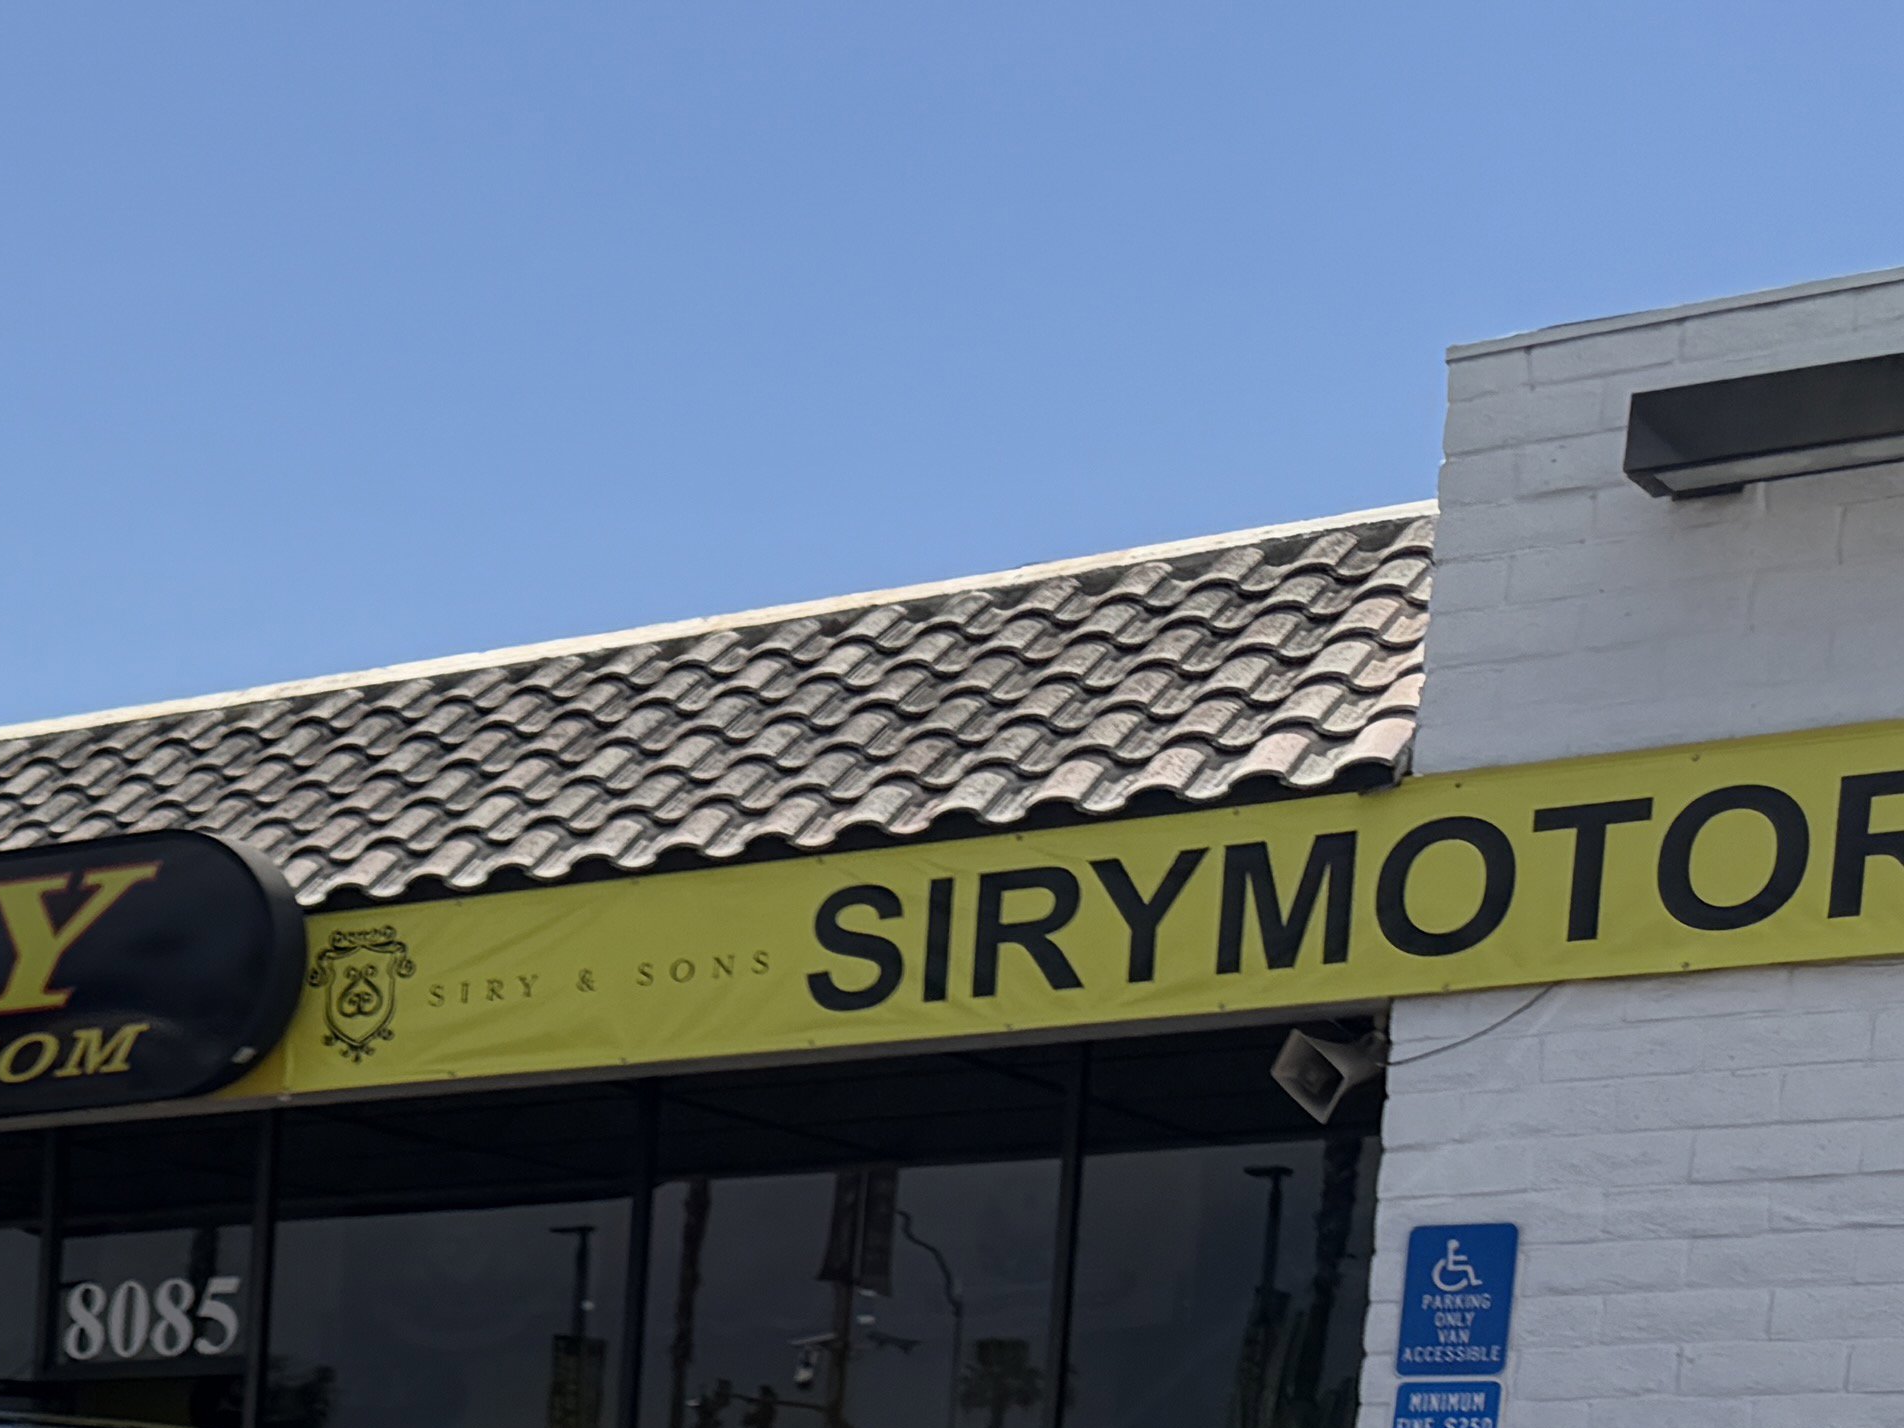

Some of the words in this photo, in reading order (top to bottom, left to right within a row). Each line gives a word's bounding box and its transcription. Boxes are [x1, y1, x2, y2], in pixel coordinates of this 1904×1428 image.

[427, 974, 539, 1009] SIRY
[575, 968, 597, 994] &
[635, 949, 772, 988] SONS
[1422, 1293, 1492, 1310] PARKING
[63, 1275, 242, 1360] 8085
[1434, 1312, 1475, 1327] ONLY
[1438, 1328, 1470, 1344] VAN
[1401, 1347, 1501, 1362] ACCESSIBLE
[1409, 1391, 1486, 1412] MINIMUM
